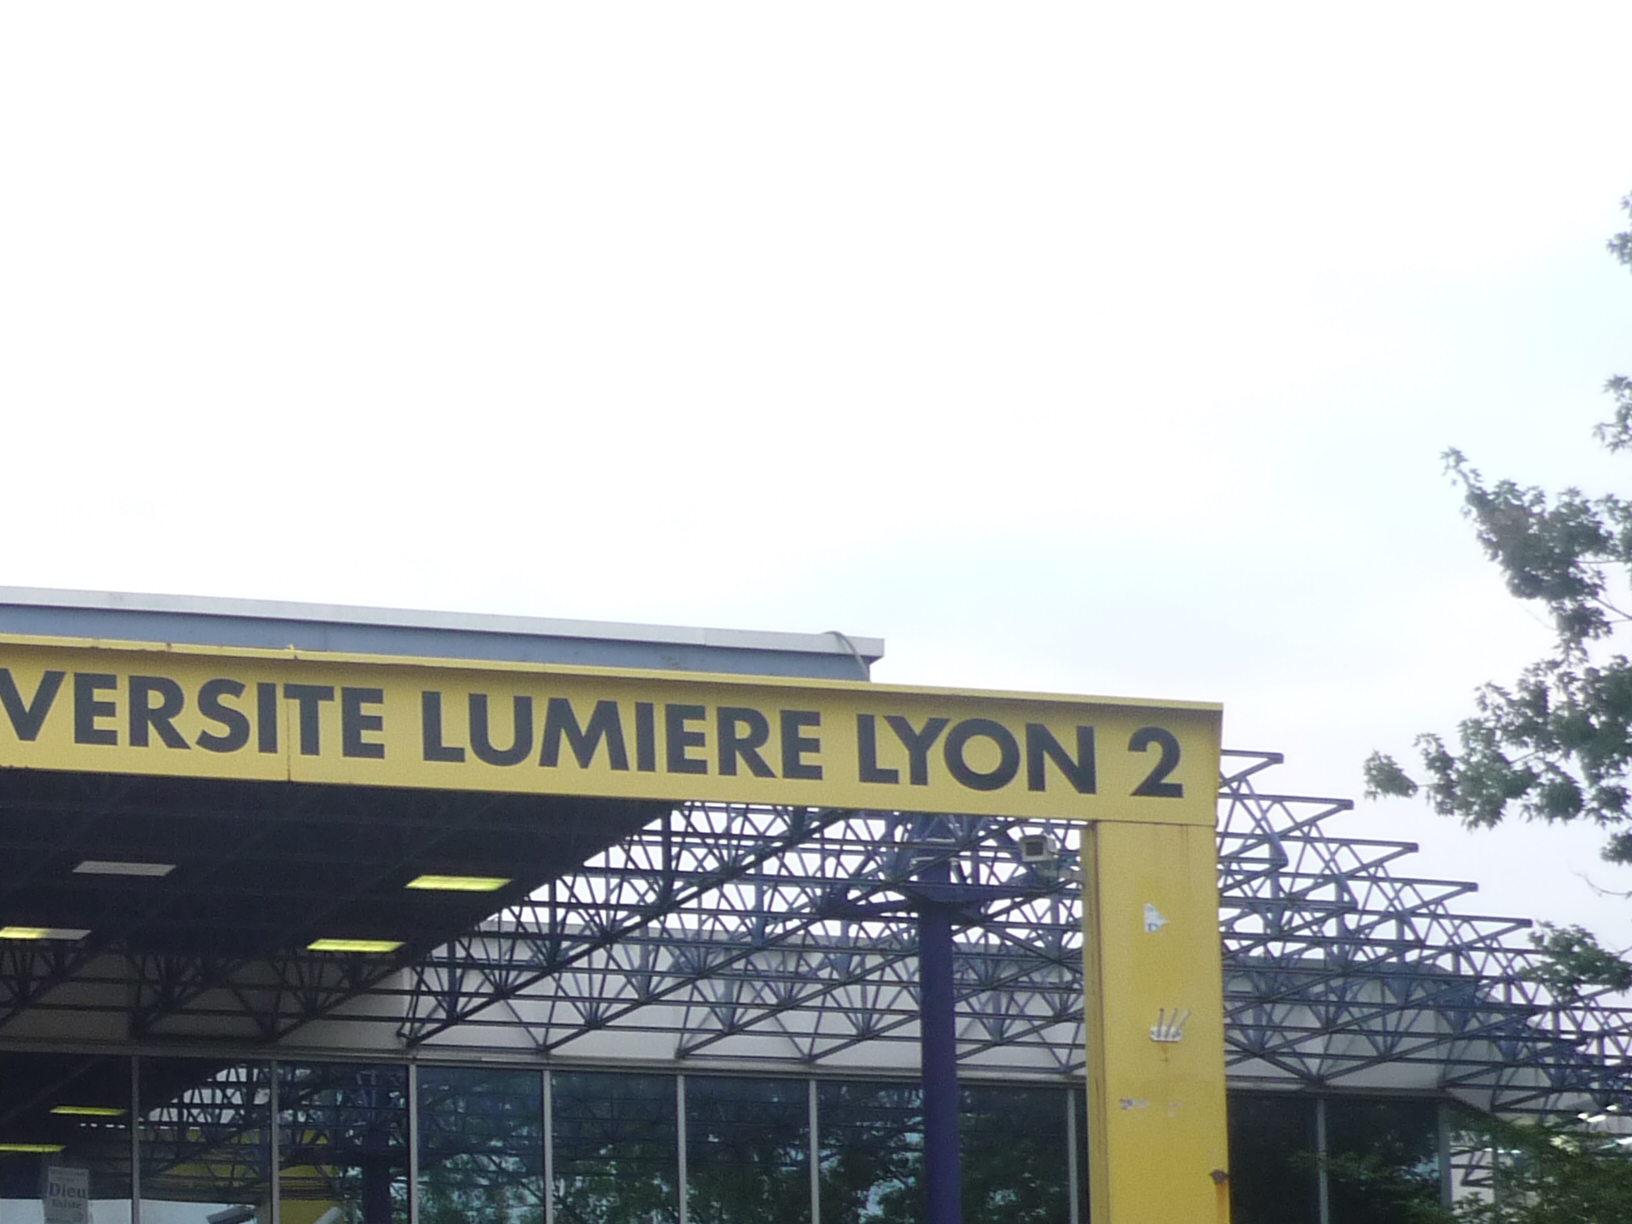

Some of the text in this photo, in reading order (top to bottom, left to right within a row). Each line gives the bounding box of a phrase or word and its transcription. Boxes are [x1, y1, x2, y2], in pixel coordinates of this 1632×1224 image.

[421, 690, 824, 781] LUMIERE
[855, 714, 1096, 794] LYON
[1128, 726, 1183, 798] 2
[50, 1183, 86, 1198] Dieu
